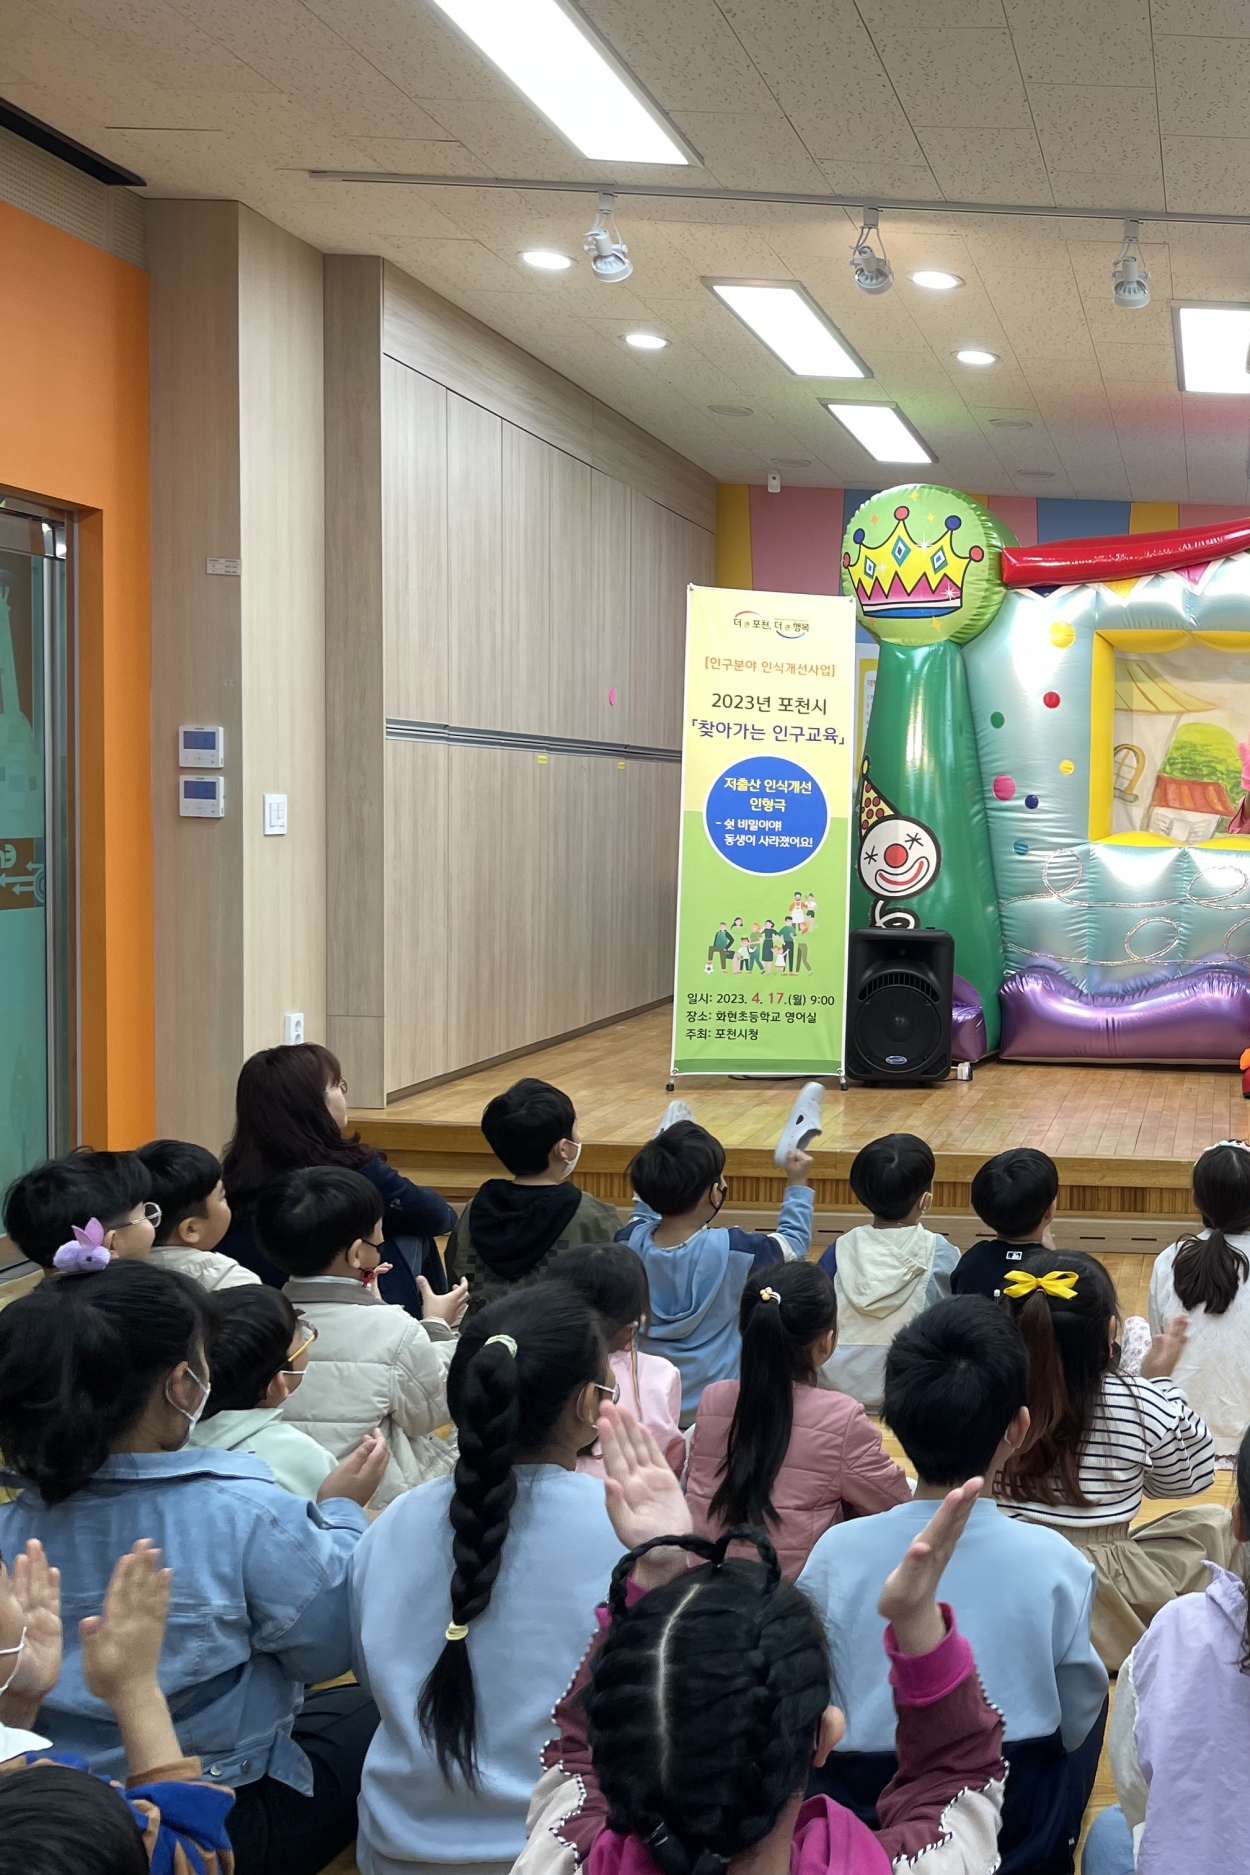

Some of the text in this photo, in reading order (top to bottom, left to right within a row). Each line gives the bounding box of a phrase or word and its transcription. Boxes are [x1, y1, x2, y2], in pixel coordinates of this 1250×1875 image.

[733, 618, 742, 628] 더
[774, 620, 783, 631] 더
[793, 621, 810, 632] 행복
[705, 656, 835, 677] [인구분야 인식개선사업]
[712, 692, 826, 716] 2023년 포천시
[692, 718, 845, 745] 「찾아가는 인구교육」
[724, 777, 812, 794] 저출산 인식개선
[749, 797, 786, 812] 인형극
[724, 834, 813, 848] 동생이 사라졌어요!
[687, 993, 713, 1005] 일시:
[717, 993, 747, 1005] 2023.
[751, 992, 763, 1004] 4.
[810, 995, 835, 1006] 9:00
[686, 1010, 817, 1024] 장소: 화현초등학교 영어실
[685, 1028, 759, 1041] 주최: 포천시청
